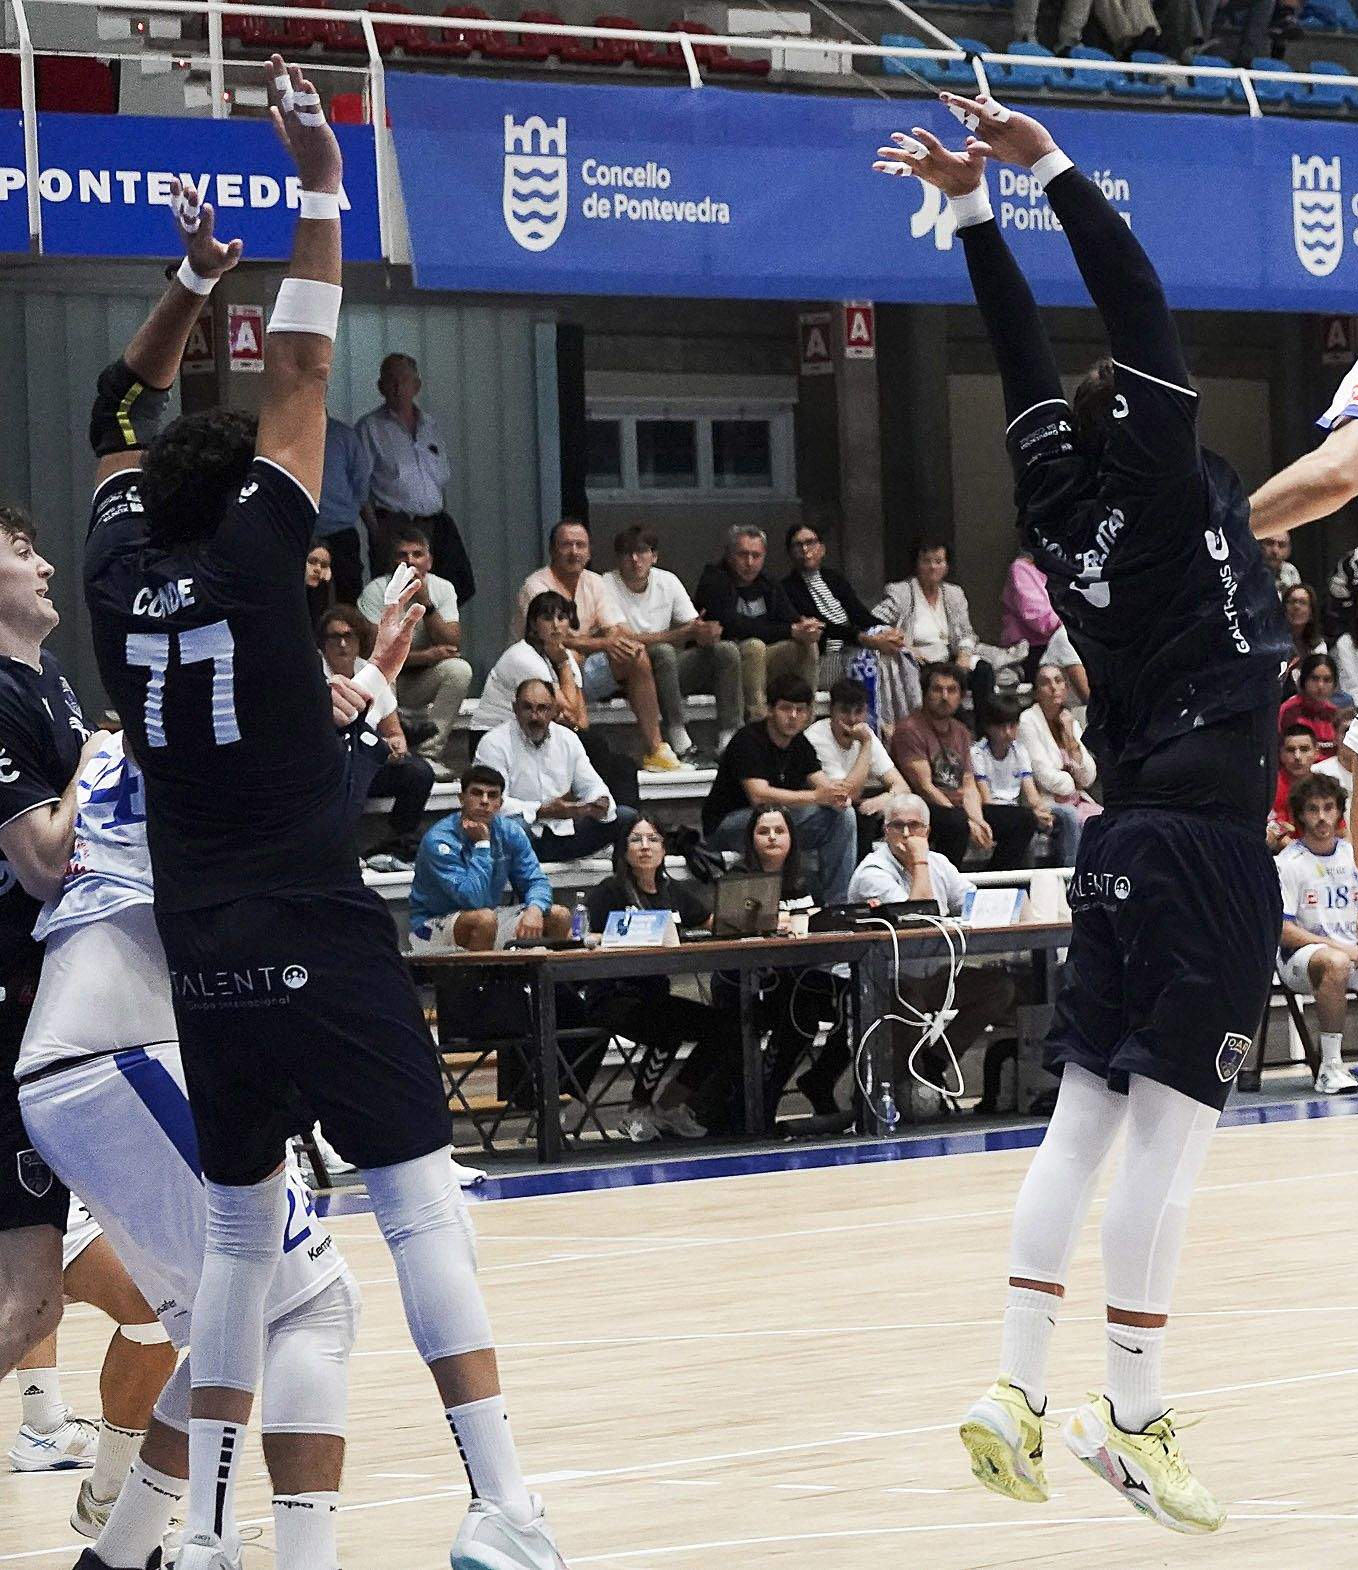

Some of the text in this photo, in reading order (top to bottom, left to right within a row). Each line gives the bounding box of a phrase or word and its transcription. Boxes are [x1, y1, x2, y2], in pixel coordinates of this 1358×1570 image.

[582, 158, 671, 189] Concello
[1000, 168, 1130, 206] Depón
[582, 192, 731, 224] de Pontevedra
[231, 320, 259, 353] A
[849, 311, 871, 342] A
[125, 618, 243, 748] 77
[1325, 884, 1350, 910] 18
